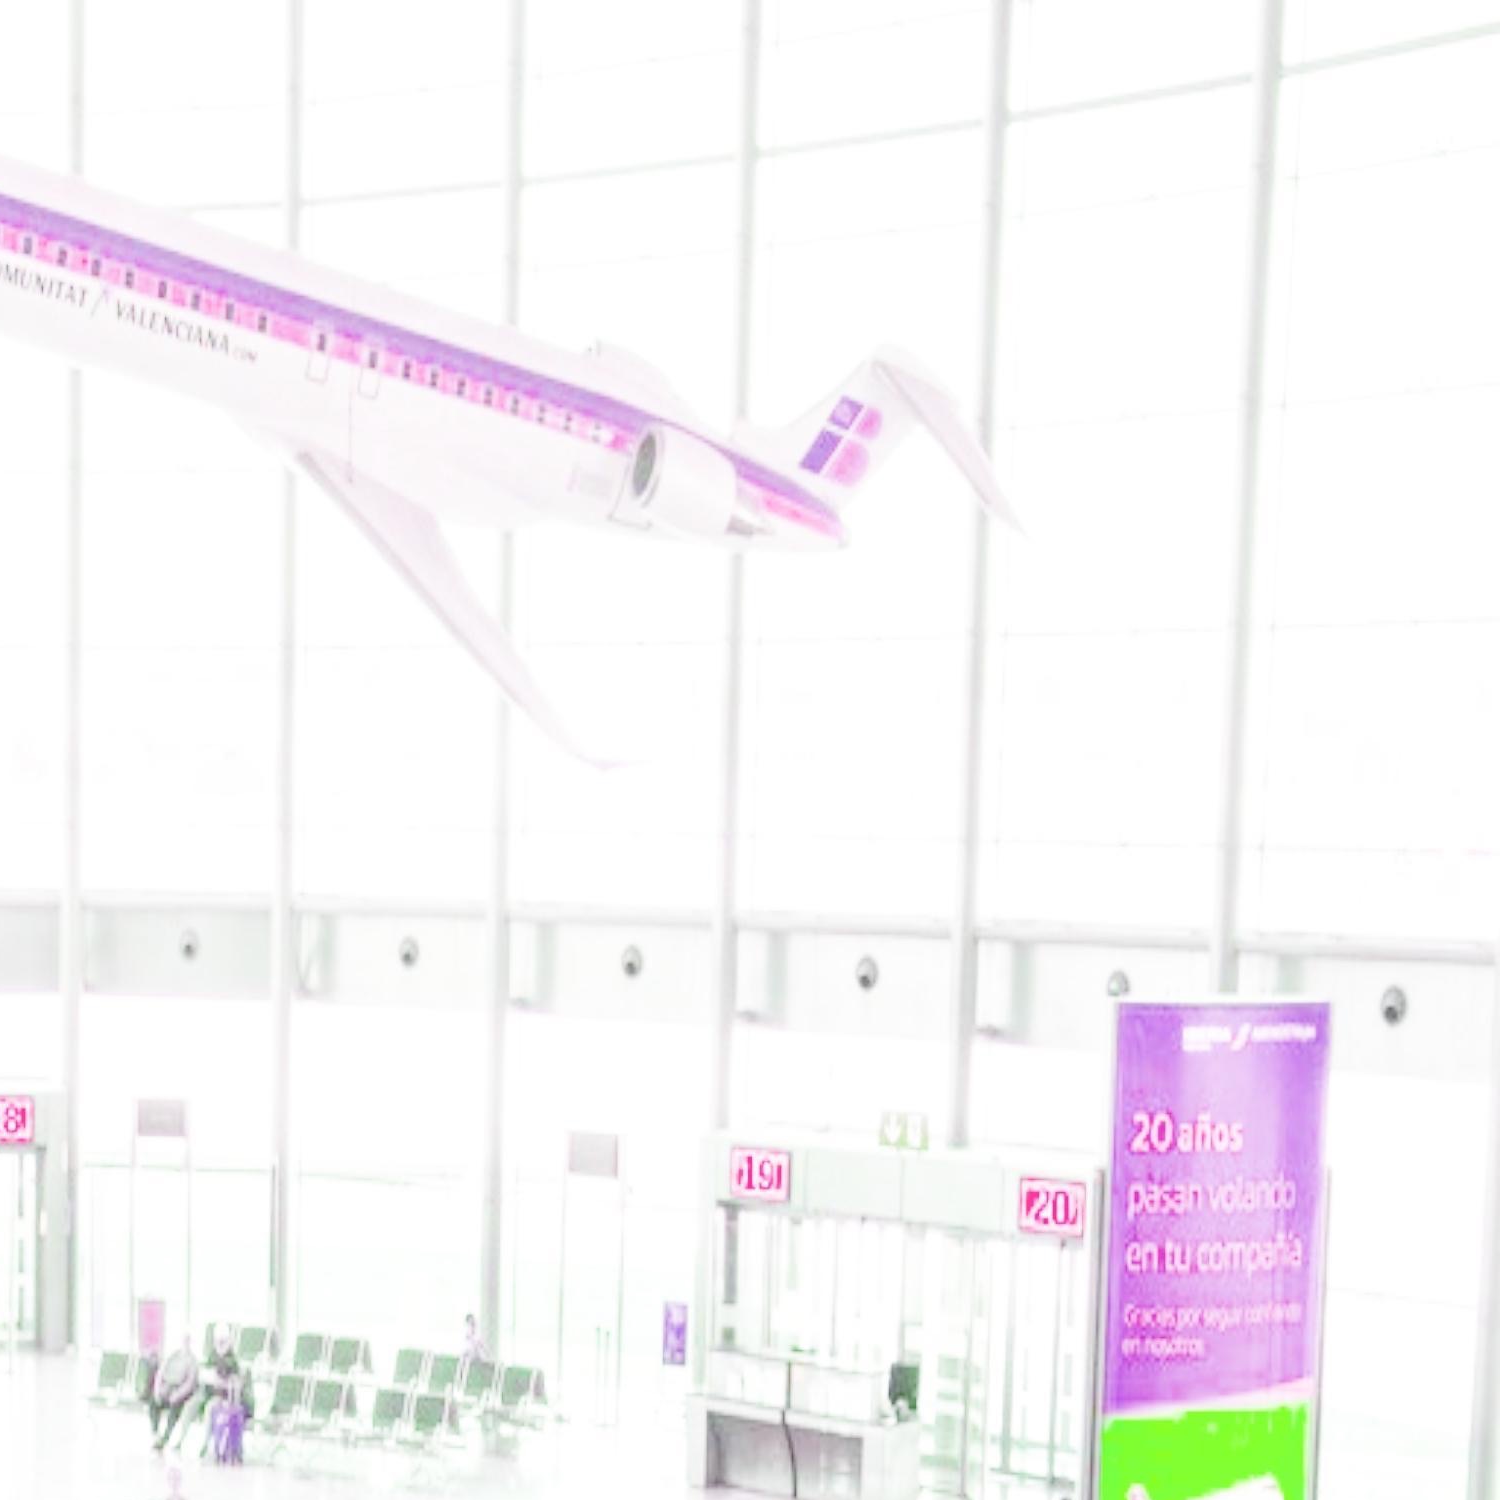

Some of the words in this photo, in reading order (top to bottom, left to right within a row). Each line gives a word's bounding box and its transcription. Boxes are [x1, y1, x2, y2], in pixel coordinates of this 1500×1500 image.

[1131, 1112, 1174, 1154] 20
[1177, 1112, 1243, 1153] años
[739, 1156, 779, 1190] 19
[1029, 1191, 1075, 1225] 20
[1127, 1182, 1202, 1220] pasan
[1207, 1172, 1297, 1213] volando
[1126, 1241, 1159, 1272] en
[1164, 1238, 1192, 1272] tu
